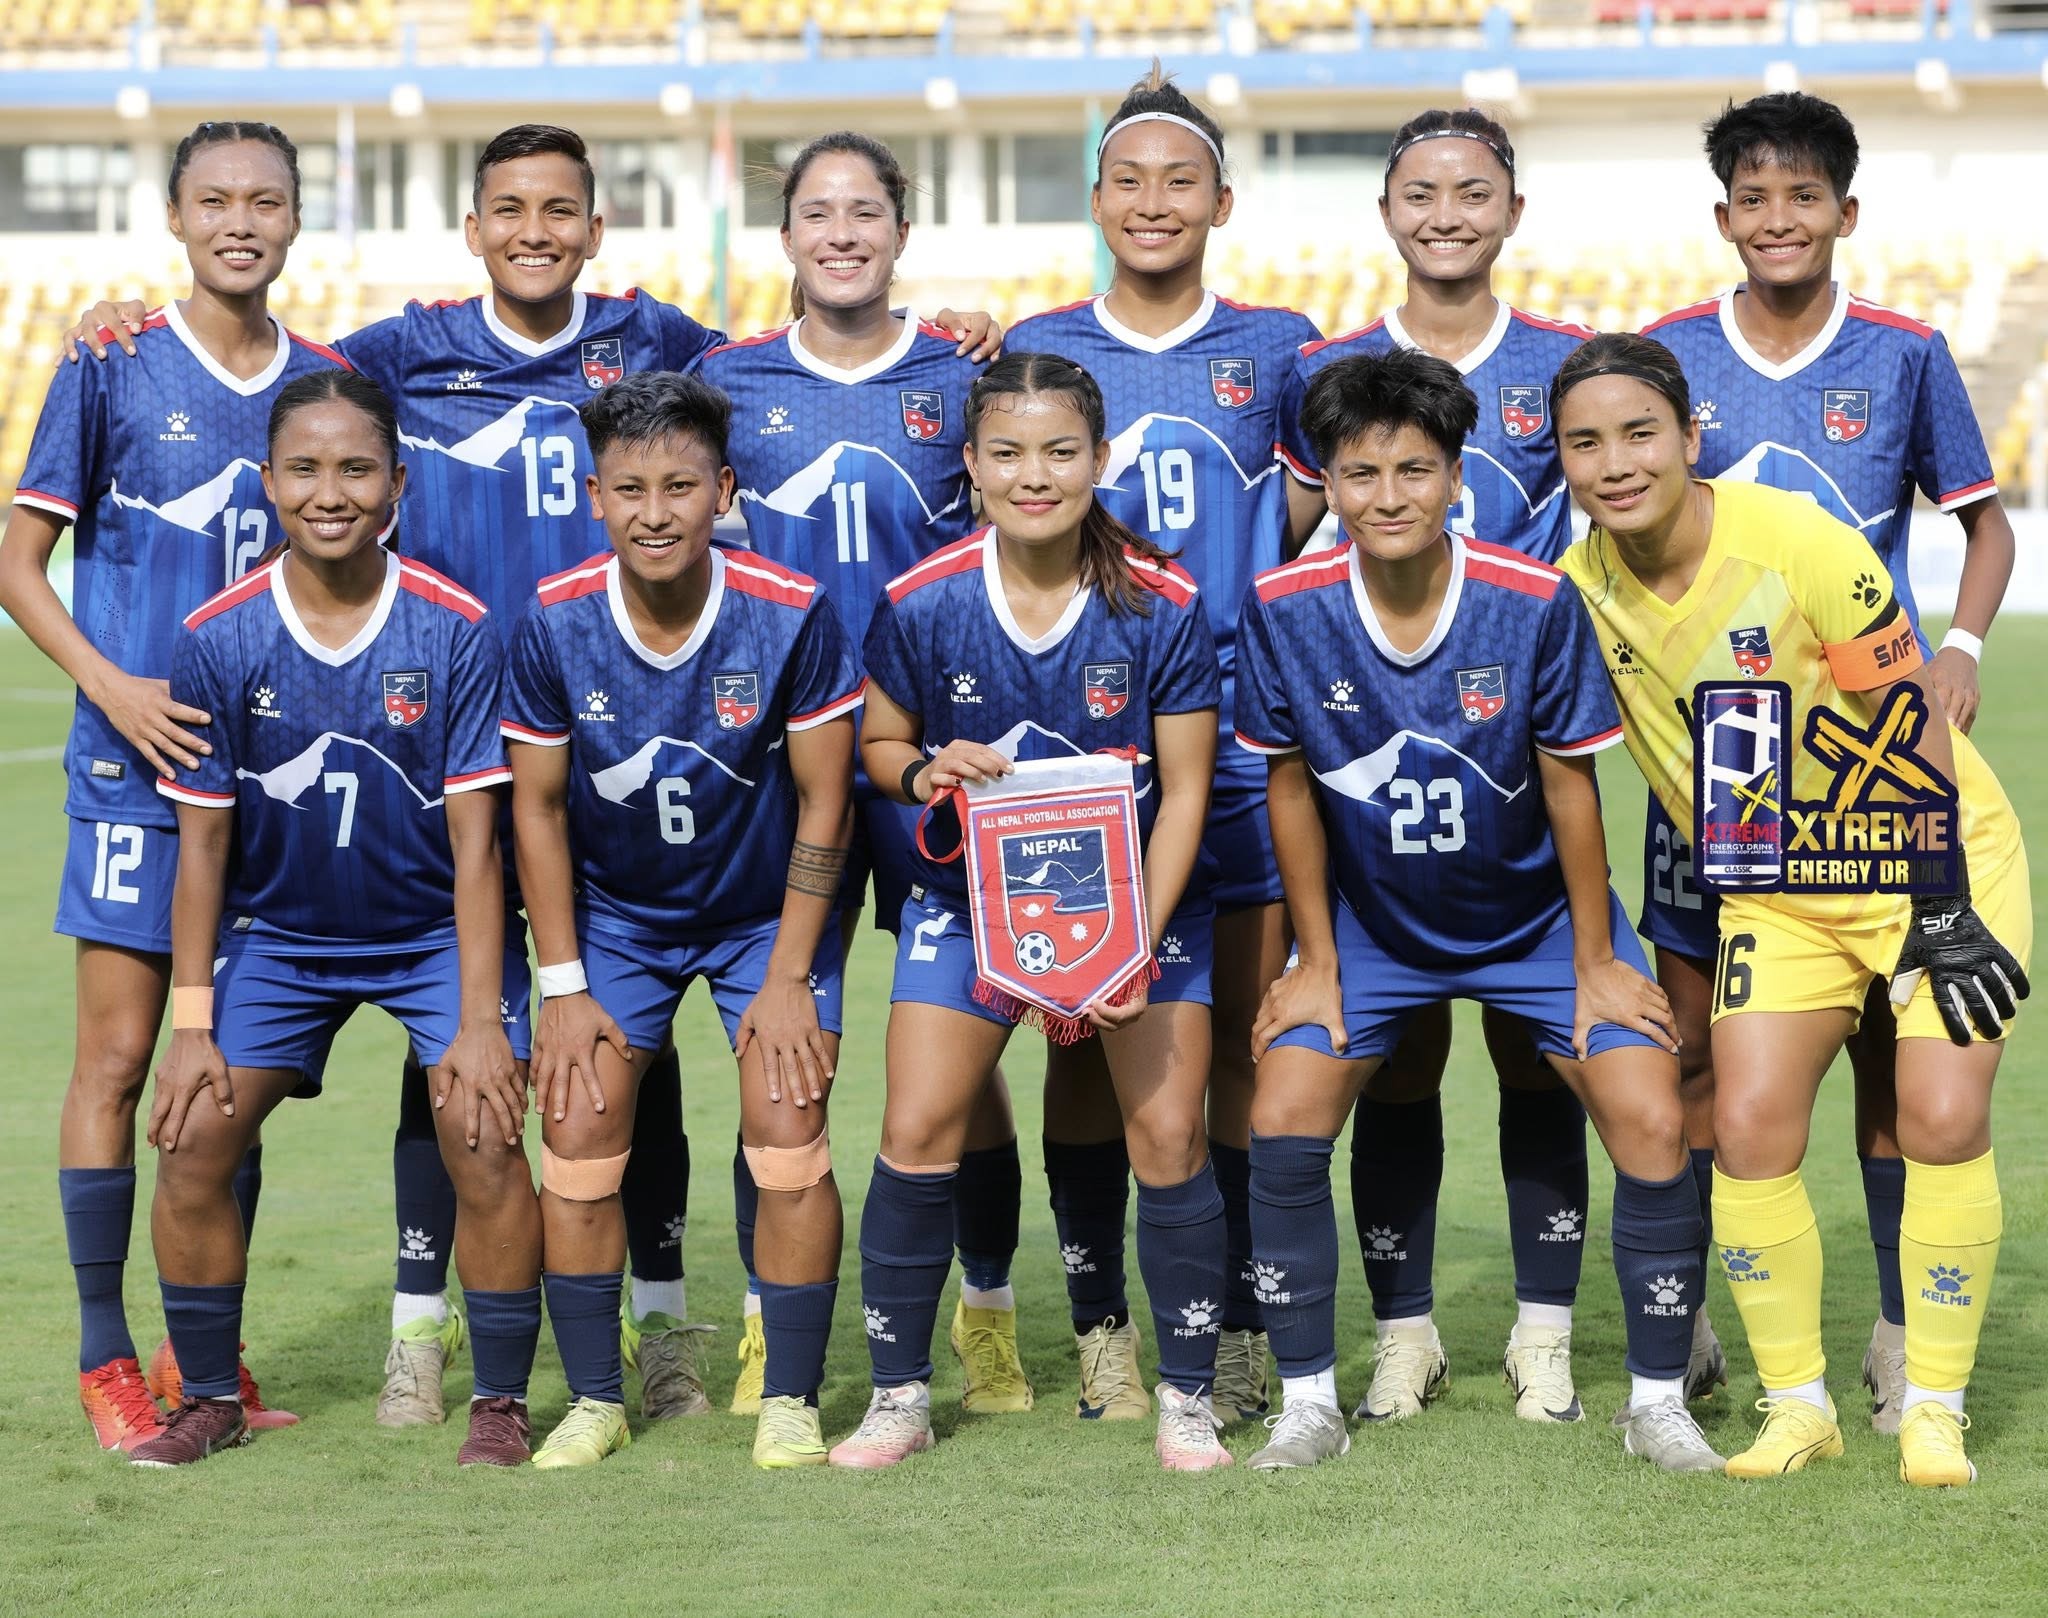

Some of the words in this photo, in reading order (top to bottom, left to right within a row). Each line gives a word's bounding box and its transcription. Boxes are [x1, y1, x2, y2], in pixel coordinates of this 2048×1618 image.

[448, 381, 482, 390] KELME
[760, 425, 794, 435] KELME
[1697, 421, 1722, 430] ELME
[521, 436, 577, 516] 13
[1139, 448, 1195, 532] 19
[832, 482, 869, 562] 11
[223, 508, 268, 588] 12
[1738, 630, 1758, 638] NEPAL
[1469, 672, 1491, 680] NEPAL
[1611, 667, 1645, 675] KELME
[1323, 701, 1360, 712] KELME
[250, 707, 281, 718] KELME
[578, 712, 615, 721] KELME
[324, 772, 359, 847] 7
[656, 777, 695, 844] 6
[1389, 777, 1466, 853] 23
[981, 817, 996, 829] ALL
[998, 814, 1023, 827] NEPAL
[1024, 810, 1065, 824] FOOTBALL
[1067, 804, 1119, 819] ASSOCIATION
[1021, 837, 1082, 857] NEPAL
[91, 822, 144, 904] 12
[908, 908, 955, 962] 2
[1713, 933, 1756, 1015] 16
[1539, 1232, 1582, 1242] KELME
[400, 1250, 435, 1260] KELME
[1364, 1251, 1407, 1260] KELME
[1066, 1263, 1096, 1273] ELME
[1724, 1271, 1770, 1281] KELME
[1921, 1289, 1972, 1306] KELME
[1643, 1305, 1689, 1316] KELME
[1174, 1323, 1220, 1338] KELME
